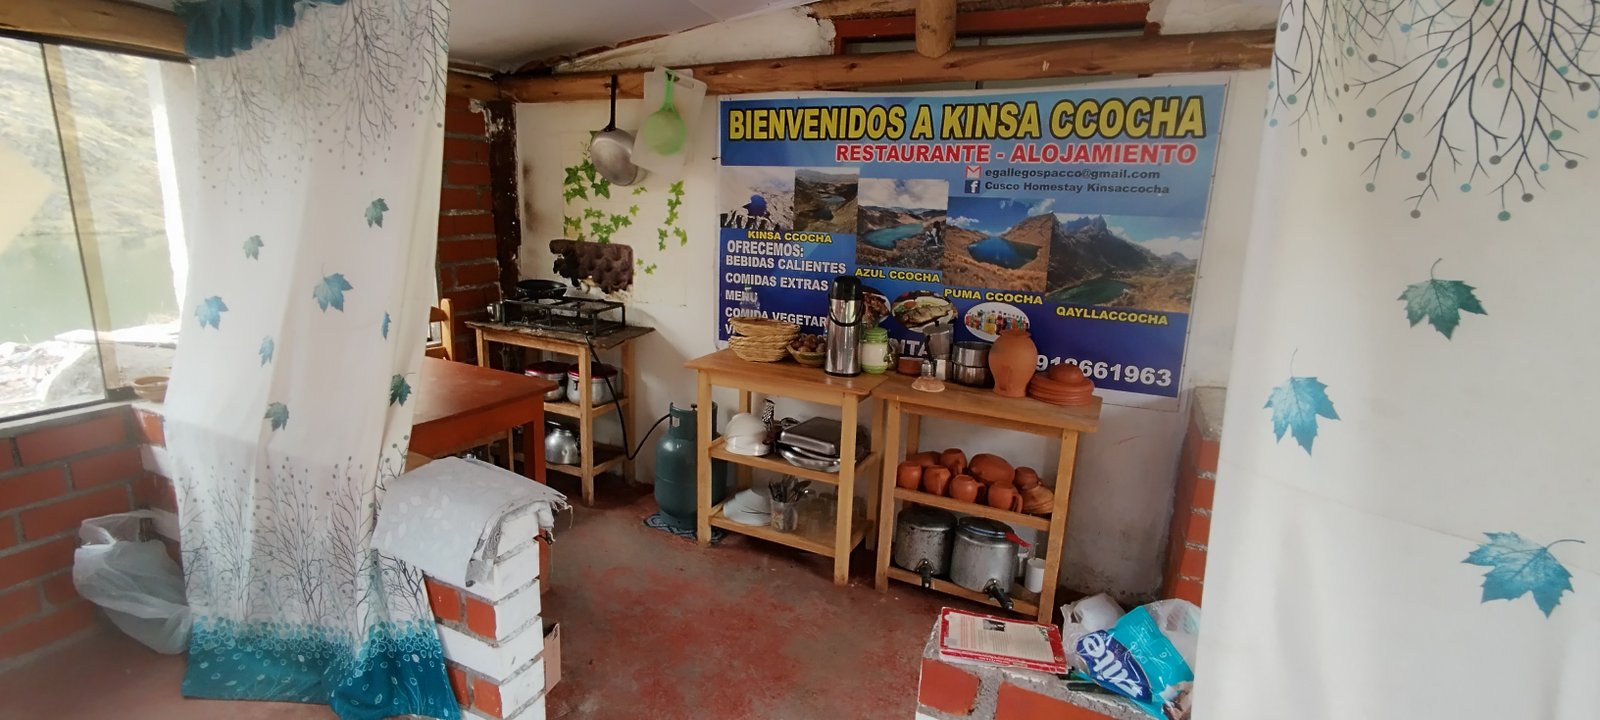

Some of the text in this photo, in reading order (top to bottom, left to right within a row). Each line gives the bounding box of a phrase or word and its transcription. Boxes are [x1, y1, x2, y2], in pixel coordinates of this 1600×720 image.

[728, 96, 1206, 141] BIENVENIDOS A KINSA CCOCHA
[835, 143, 991, 163] RESTAURANTE
[1010, 143, 1197, 165] ALOJAMIENTO
[985, 167, 1160, 180] egallegospacco@gmail.com
[985, 181, 1170, 194] Cusco Homestay Kinsaccocha
[747, 231, 833, 243] KINSA CCOCHA
[727, 239, 804, 258] OFRECEMOS:
[726, 255, 847, 274] BEBIDAS CALIENTES
[726, 273, 829, 291] COMIDAS EXTRAS
[855, 267, 940, 283] AZUL CCOCHA
[944, 288, 1043, 305] PUMA CCOCHA
[725, 307, 768, 319] COMIDA
[1056, 306, 1168, 325] QAYLLACCOCHA
